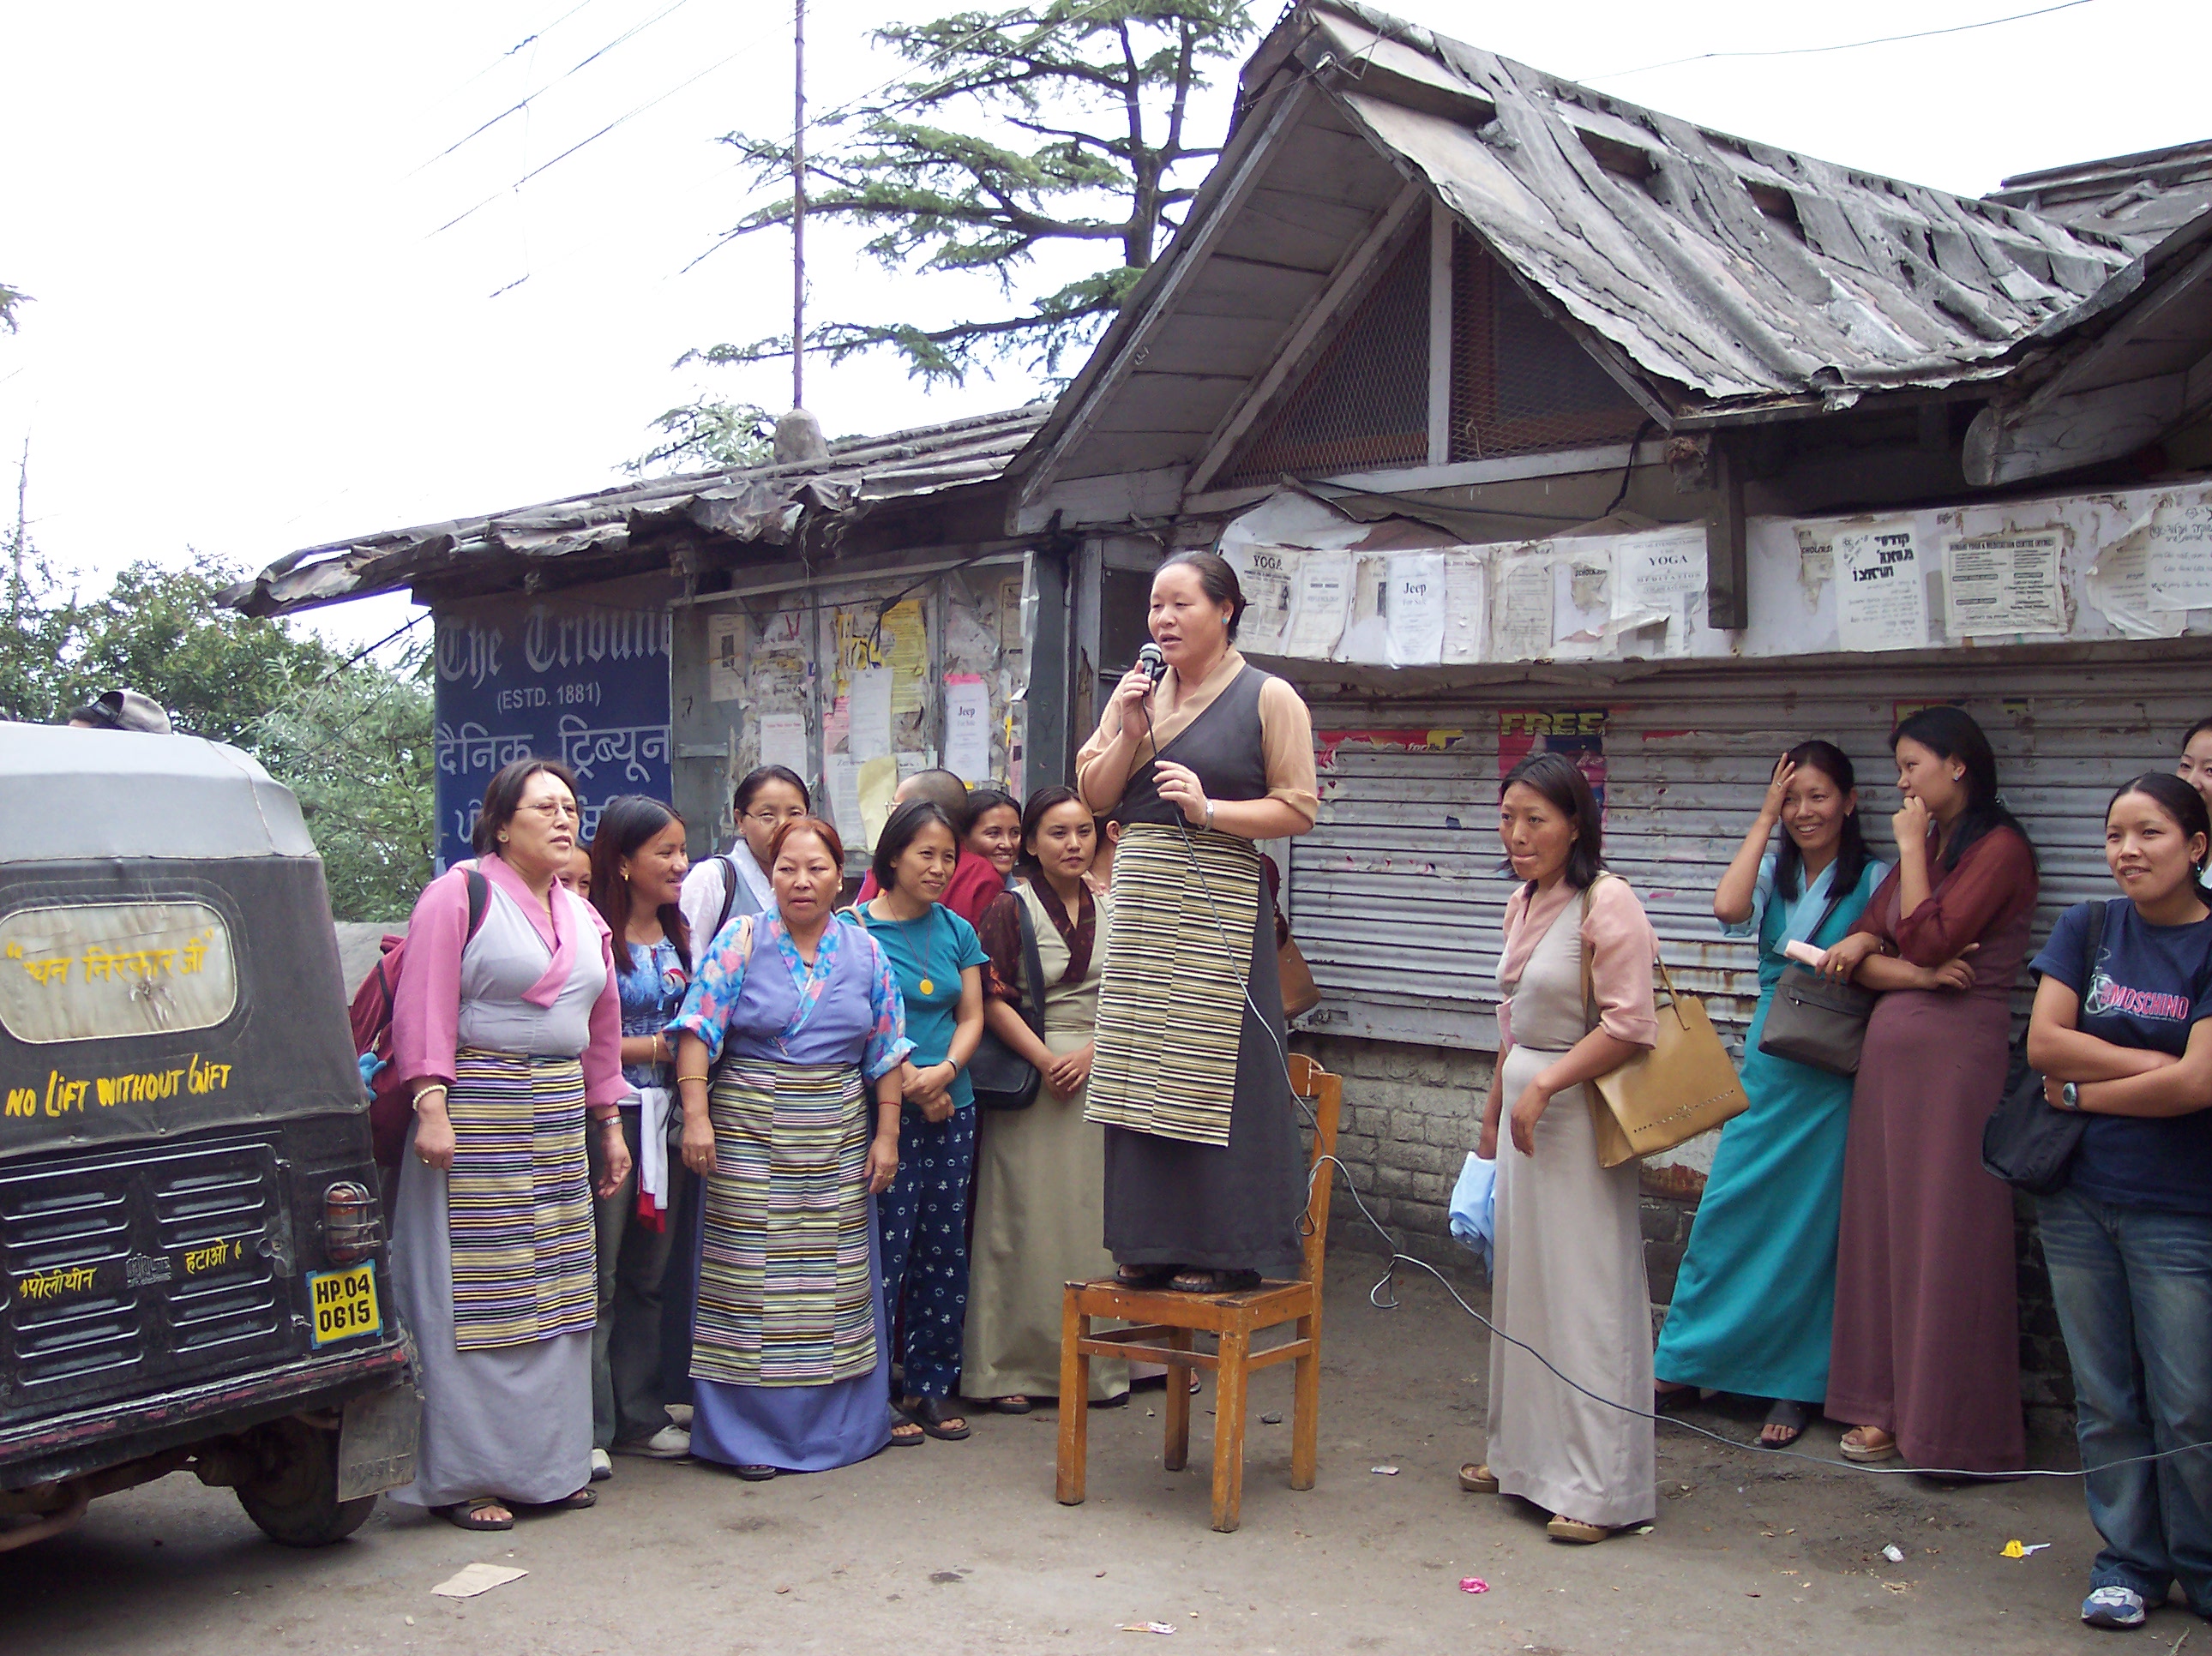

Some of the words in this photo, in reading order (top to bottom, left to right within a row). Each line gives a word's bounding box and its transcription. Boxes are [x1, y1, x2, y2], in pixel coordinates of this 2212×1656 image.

[1253, 555, 1283, 570] YOGA
[1649, 555, 1688, 566] YOGA
[1404, 582, 1427, 596] Jeep
[437, 614, 504, 690] The
[497, 687, 551, 714] (ESTD.
[556, 681, 603, 707] 1881)
[958, 705, 976, 718] Jeep
[1500, 712, 1605, 736] FREE
[436, 721, 535, 776] दैनिक
[2110, 984, 2190, 1020] MOSCHINO
[4, 1088, 38, 1118] NO
[96, 1069, 186, 1107] WITHOUT
[319, 1299, 371, 1333] 0615
